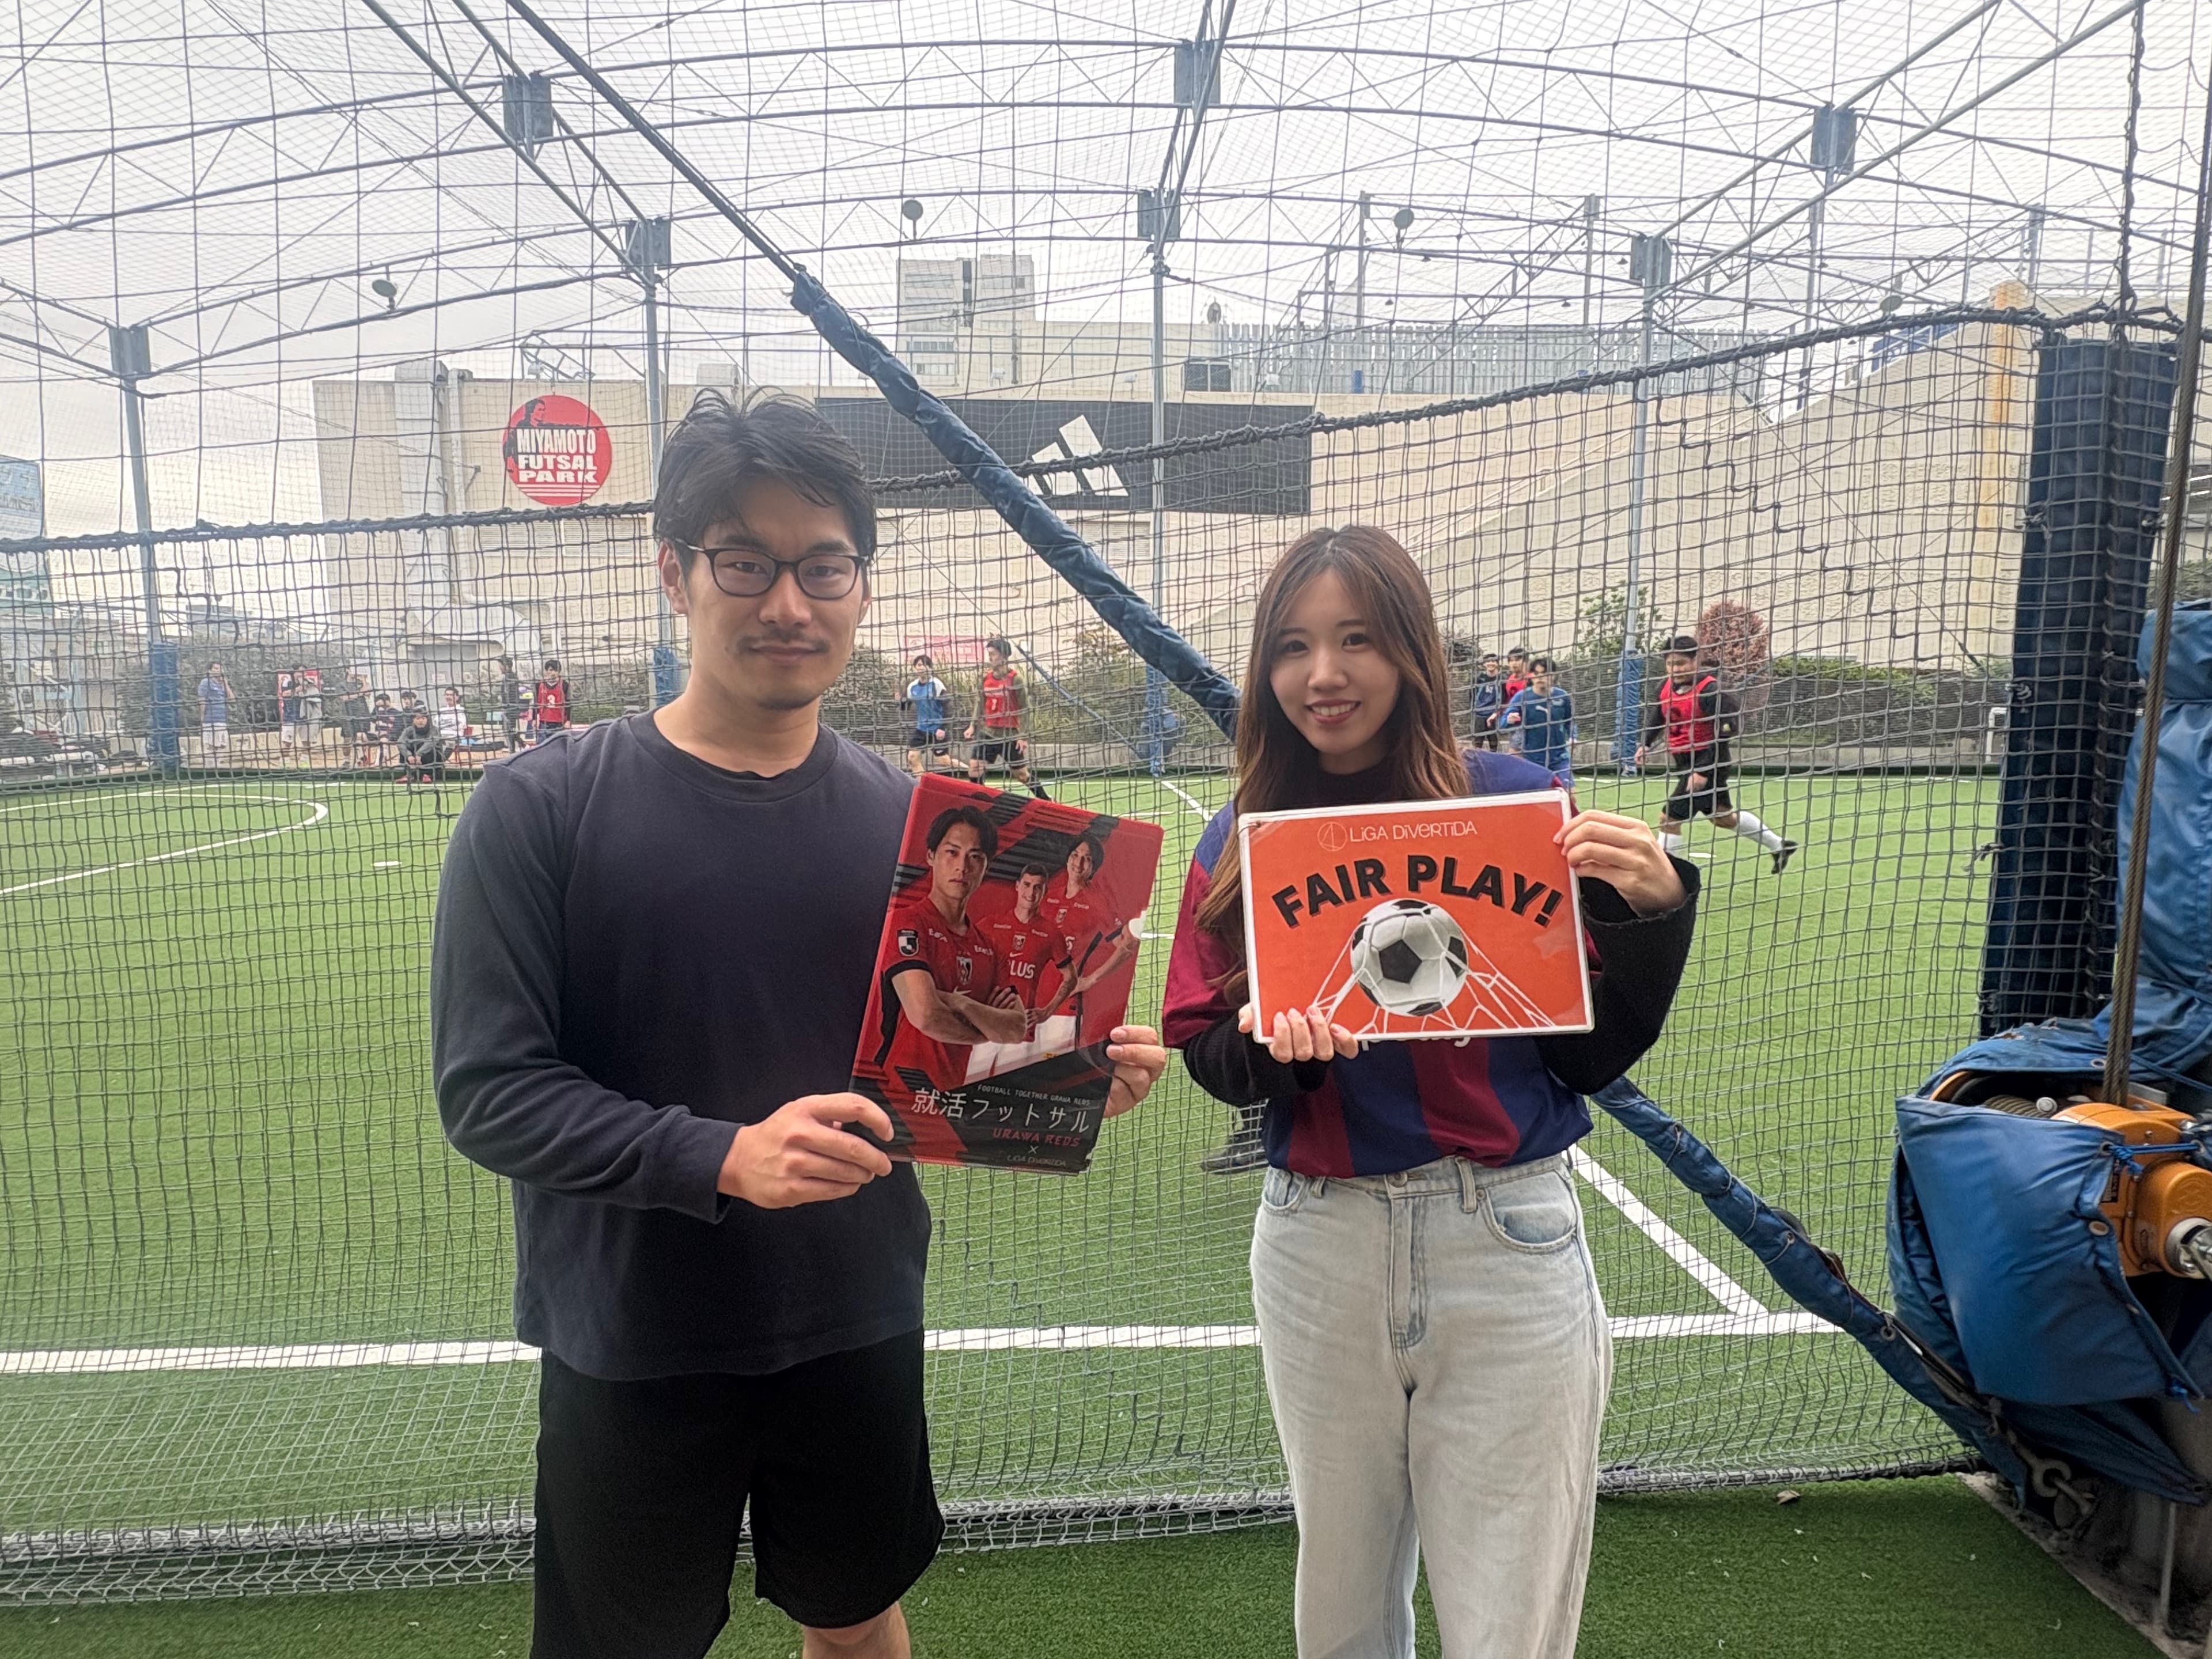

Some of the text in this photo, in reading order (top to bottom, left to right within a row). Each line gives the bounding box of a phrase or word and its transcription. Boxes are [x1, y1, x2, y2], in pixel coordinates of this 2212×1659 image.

[516, 428, 597, 454] MIYAMOTO
[518, 454, 598, 471] FUTSAL
[518, 470, 598, 483] PARK
[1271, 854, 1565, 929] FAIR PLAY!
[978, 1084, 1010, 1095] FOOTBALL
[1015, 1089, 1048, 1100] TOGETHER
[911, 1088, 1090, 1133] 就活フットサル
[992, 1127, 1081, 1147] URAWA REDS
